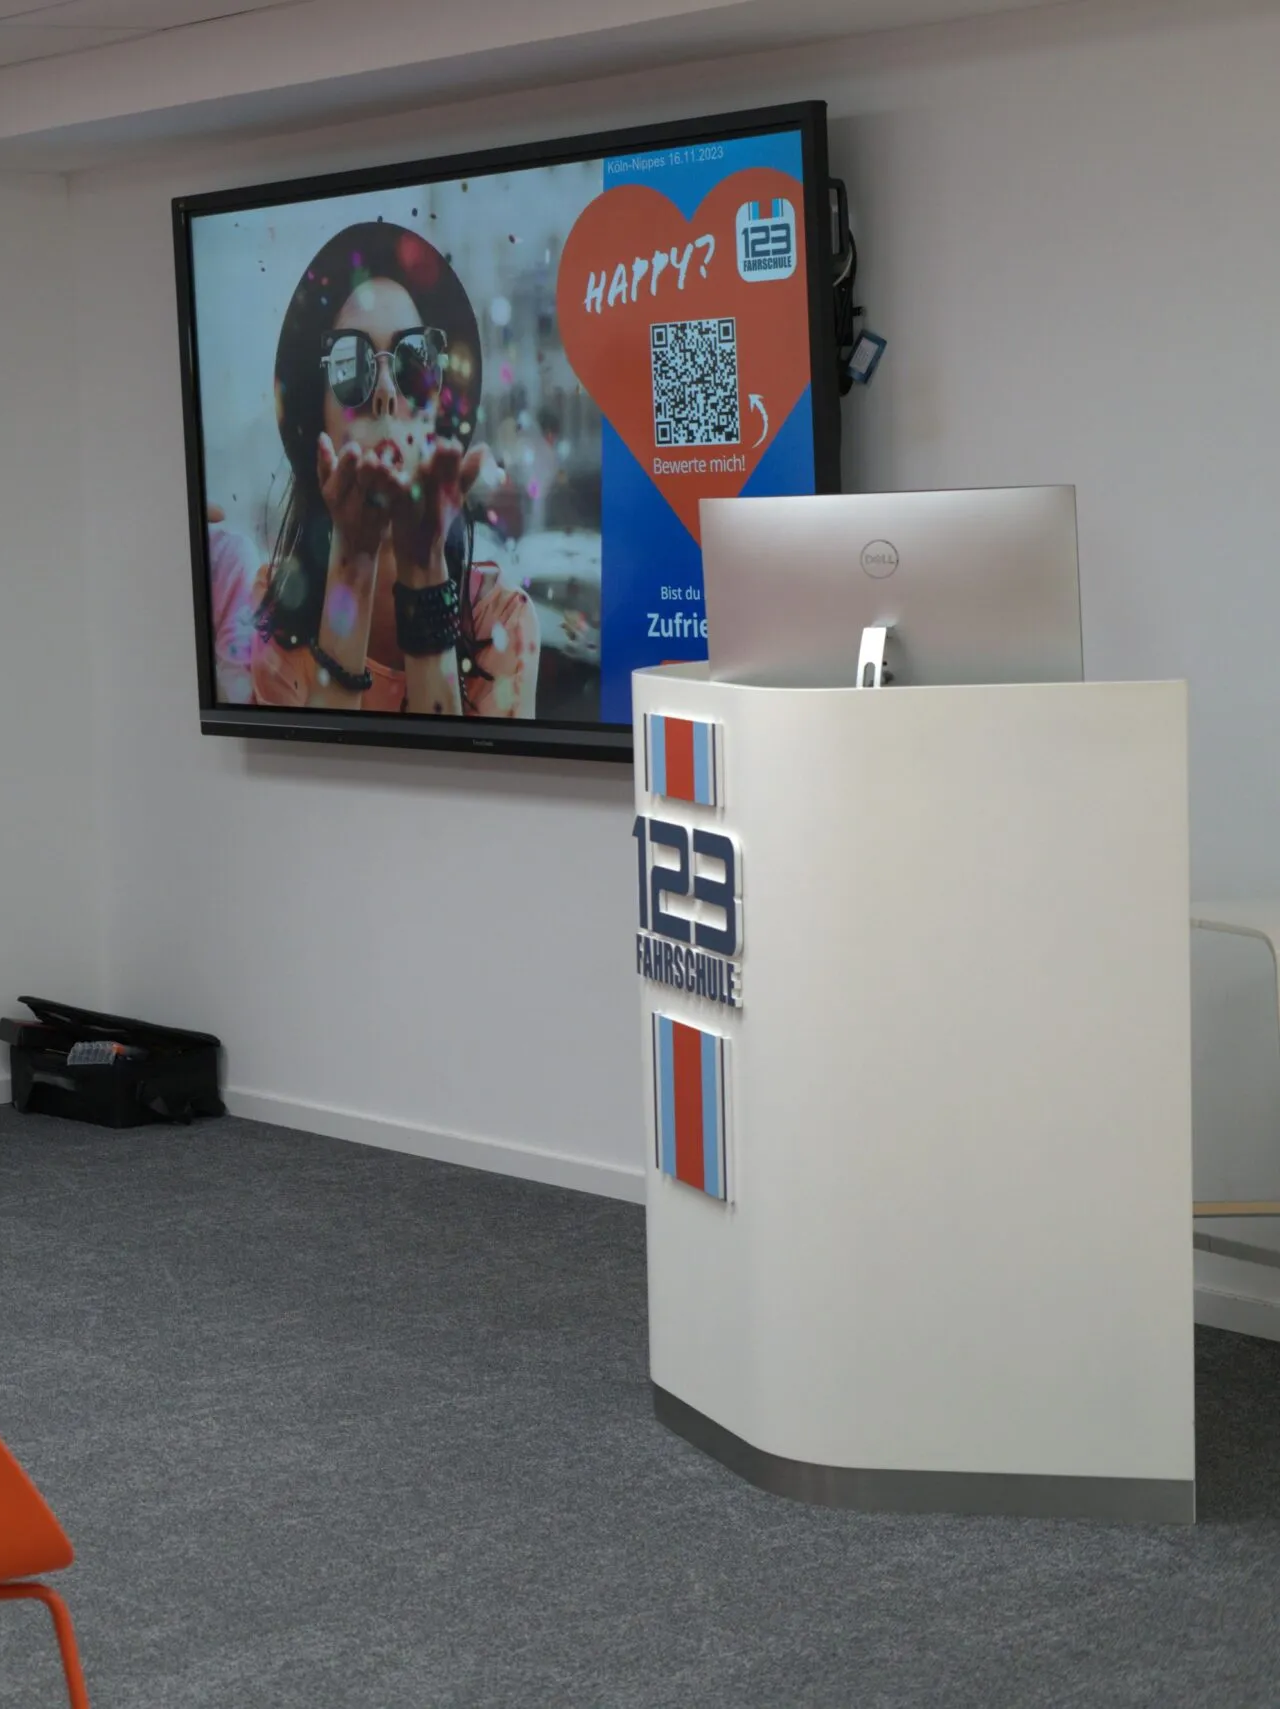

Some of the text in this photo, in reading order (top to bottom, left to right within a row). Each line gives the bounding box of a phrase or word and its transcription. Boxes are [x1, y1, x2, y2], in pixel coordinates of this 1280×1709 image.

[607, 146, 724, 174] Köln-Nippes 16.11.2023
[741, 222, 792, 259] 123
[583, 233, 716, 315] HAPPY?
[743, 255, 793, 272] FAHRSCHULE
[653, 453, 747, 475] Bewerte mich!
[864, 553, 896, 565] DELL
[660, 585, 701, 601] Bist du
[631, 814, 738, 957] 123
[636, 932, 740, 1008] FAHRSCHULE
